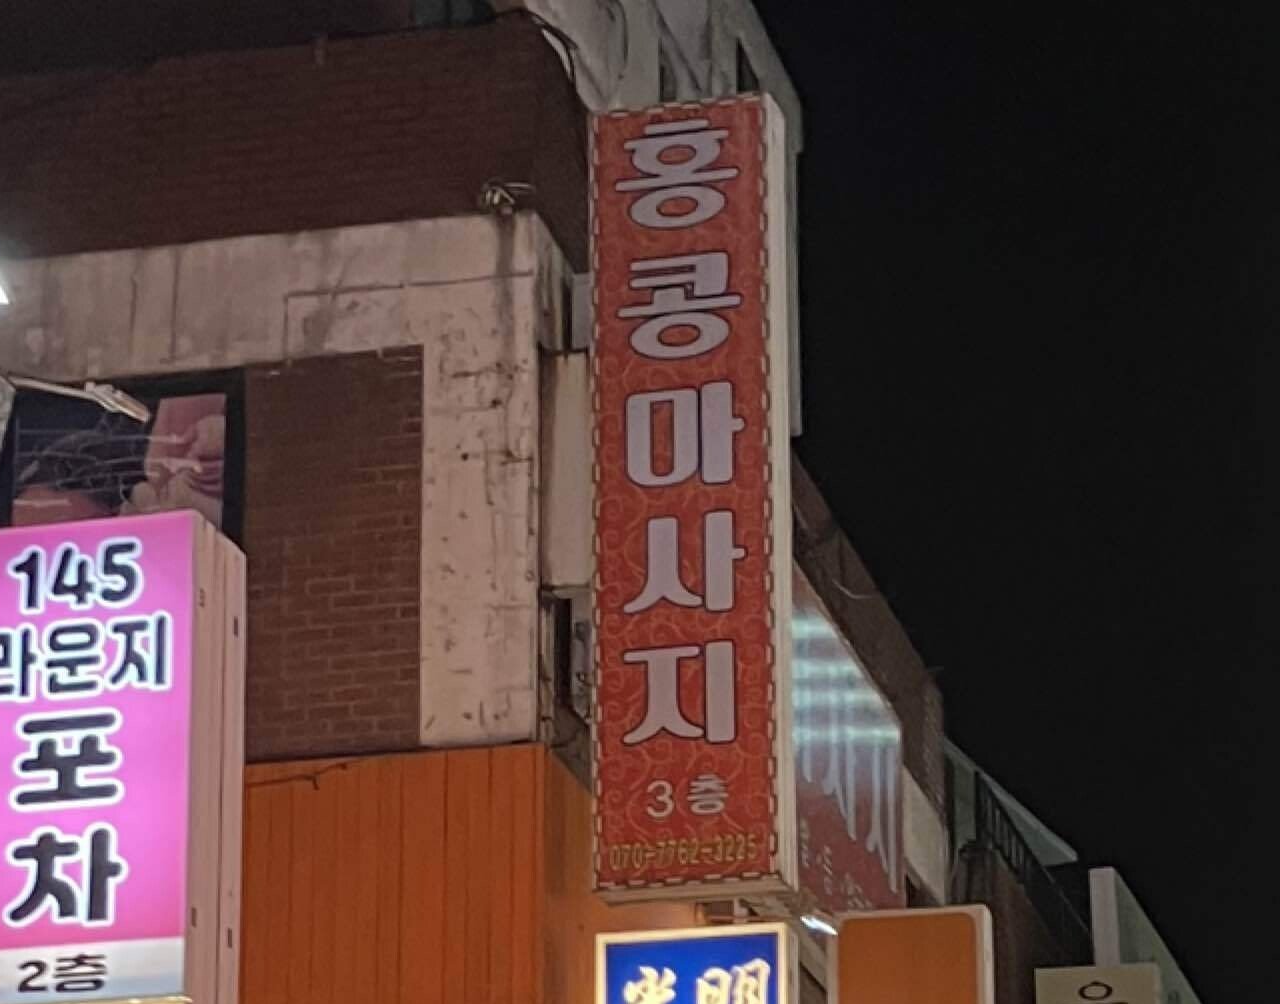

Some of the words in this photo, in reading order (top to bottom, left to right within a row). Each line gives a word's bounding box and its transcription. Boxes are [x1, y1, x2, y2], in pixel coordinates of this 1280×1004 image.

[615, 119, 747, 745] 홍콩마사지
[11, 541, 141, 610] 145
[6, 712, 126, 924] 포차
[645, 773, 732, 820] 3층
[17, 952, 109, 994] 2층
